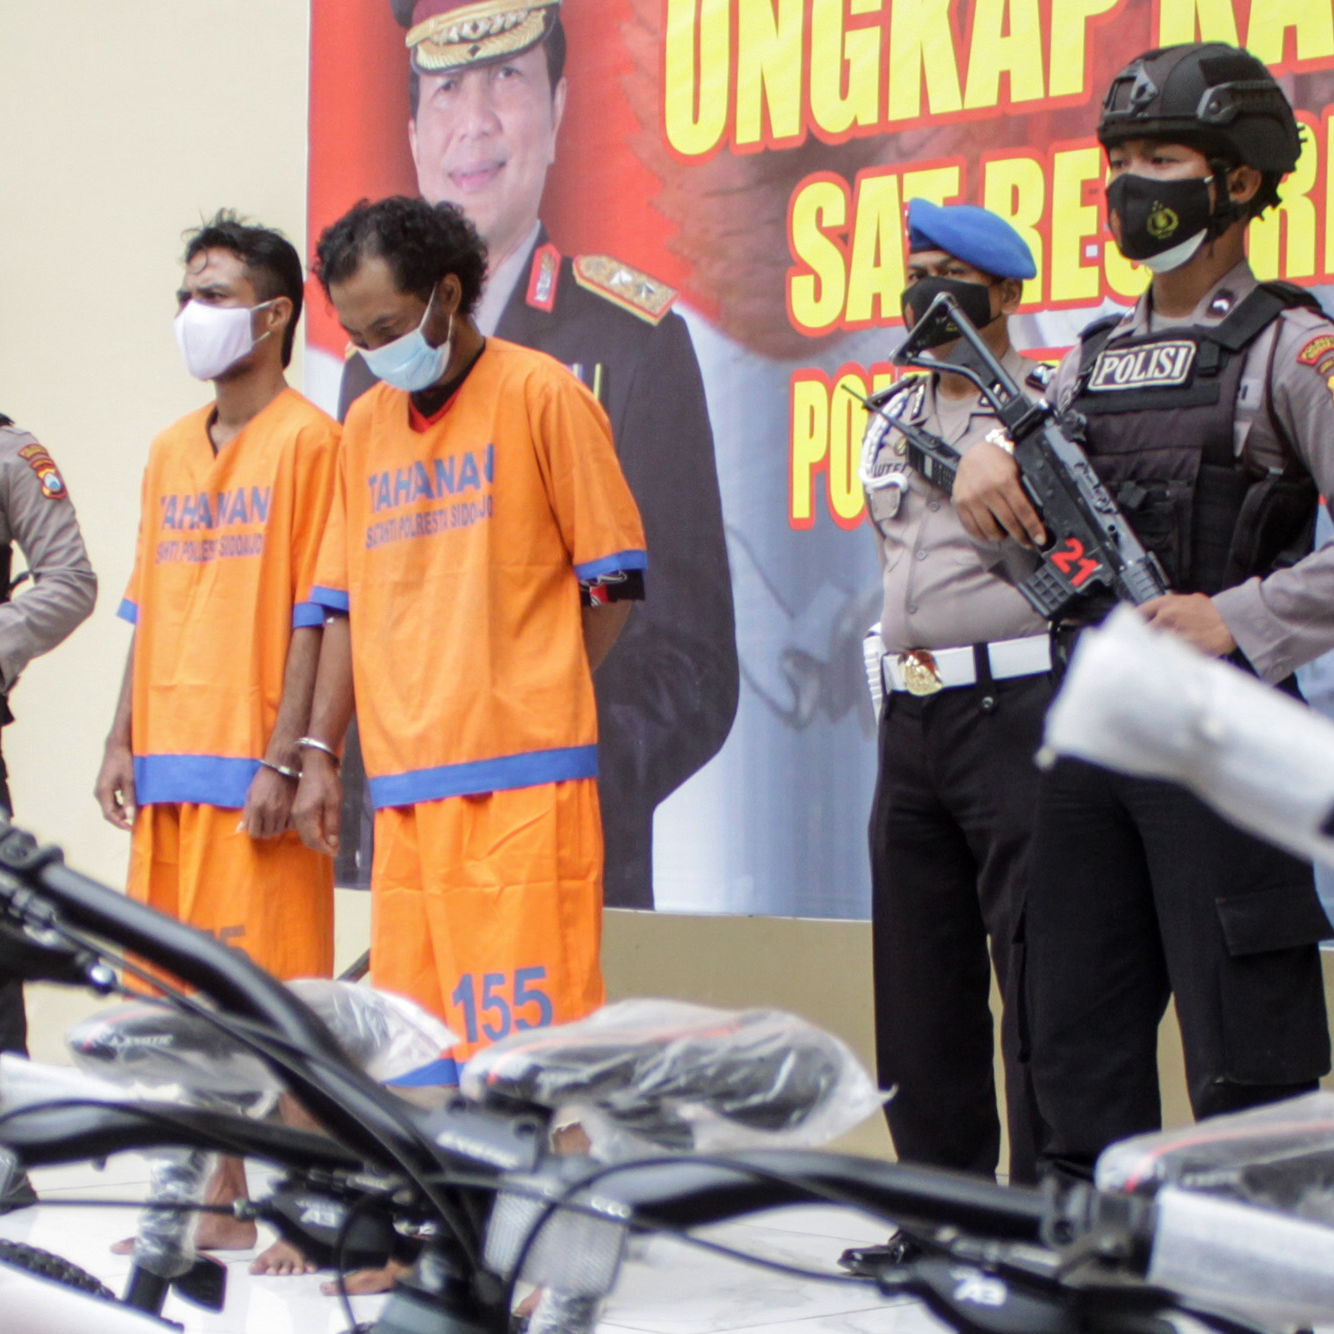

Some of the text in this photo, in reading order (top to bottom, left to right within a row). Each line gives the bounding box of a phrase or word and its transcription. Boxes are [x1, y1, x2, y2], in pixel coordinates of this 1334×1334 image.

[1093, 345, 1189, 385] POLISI
[1050, 537, 1100, 587] 21
[452, 966, 553, 1043] 155
